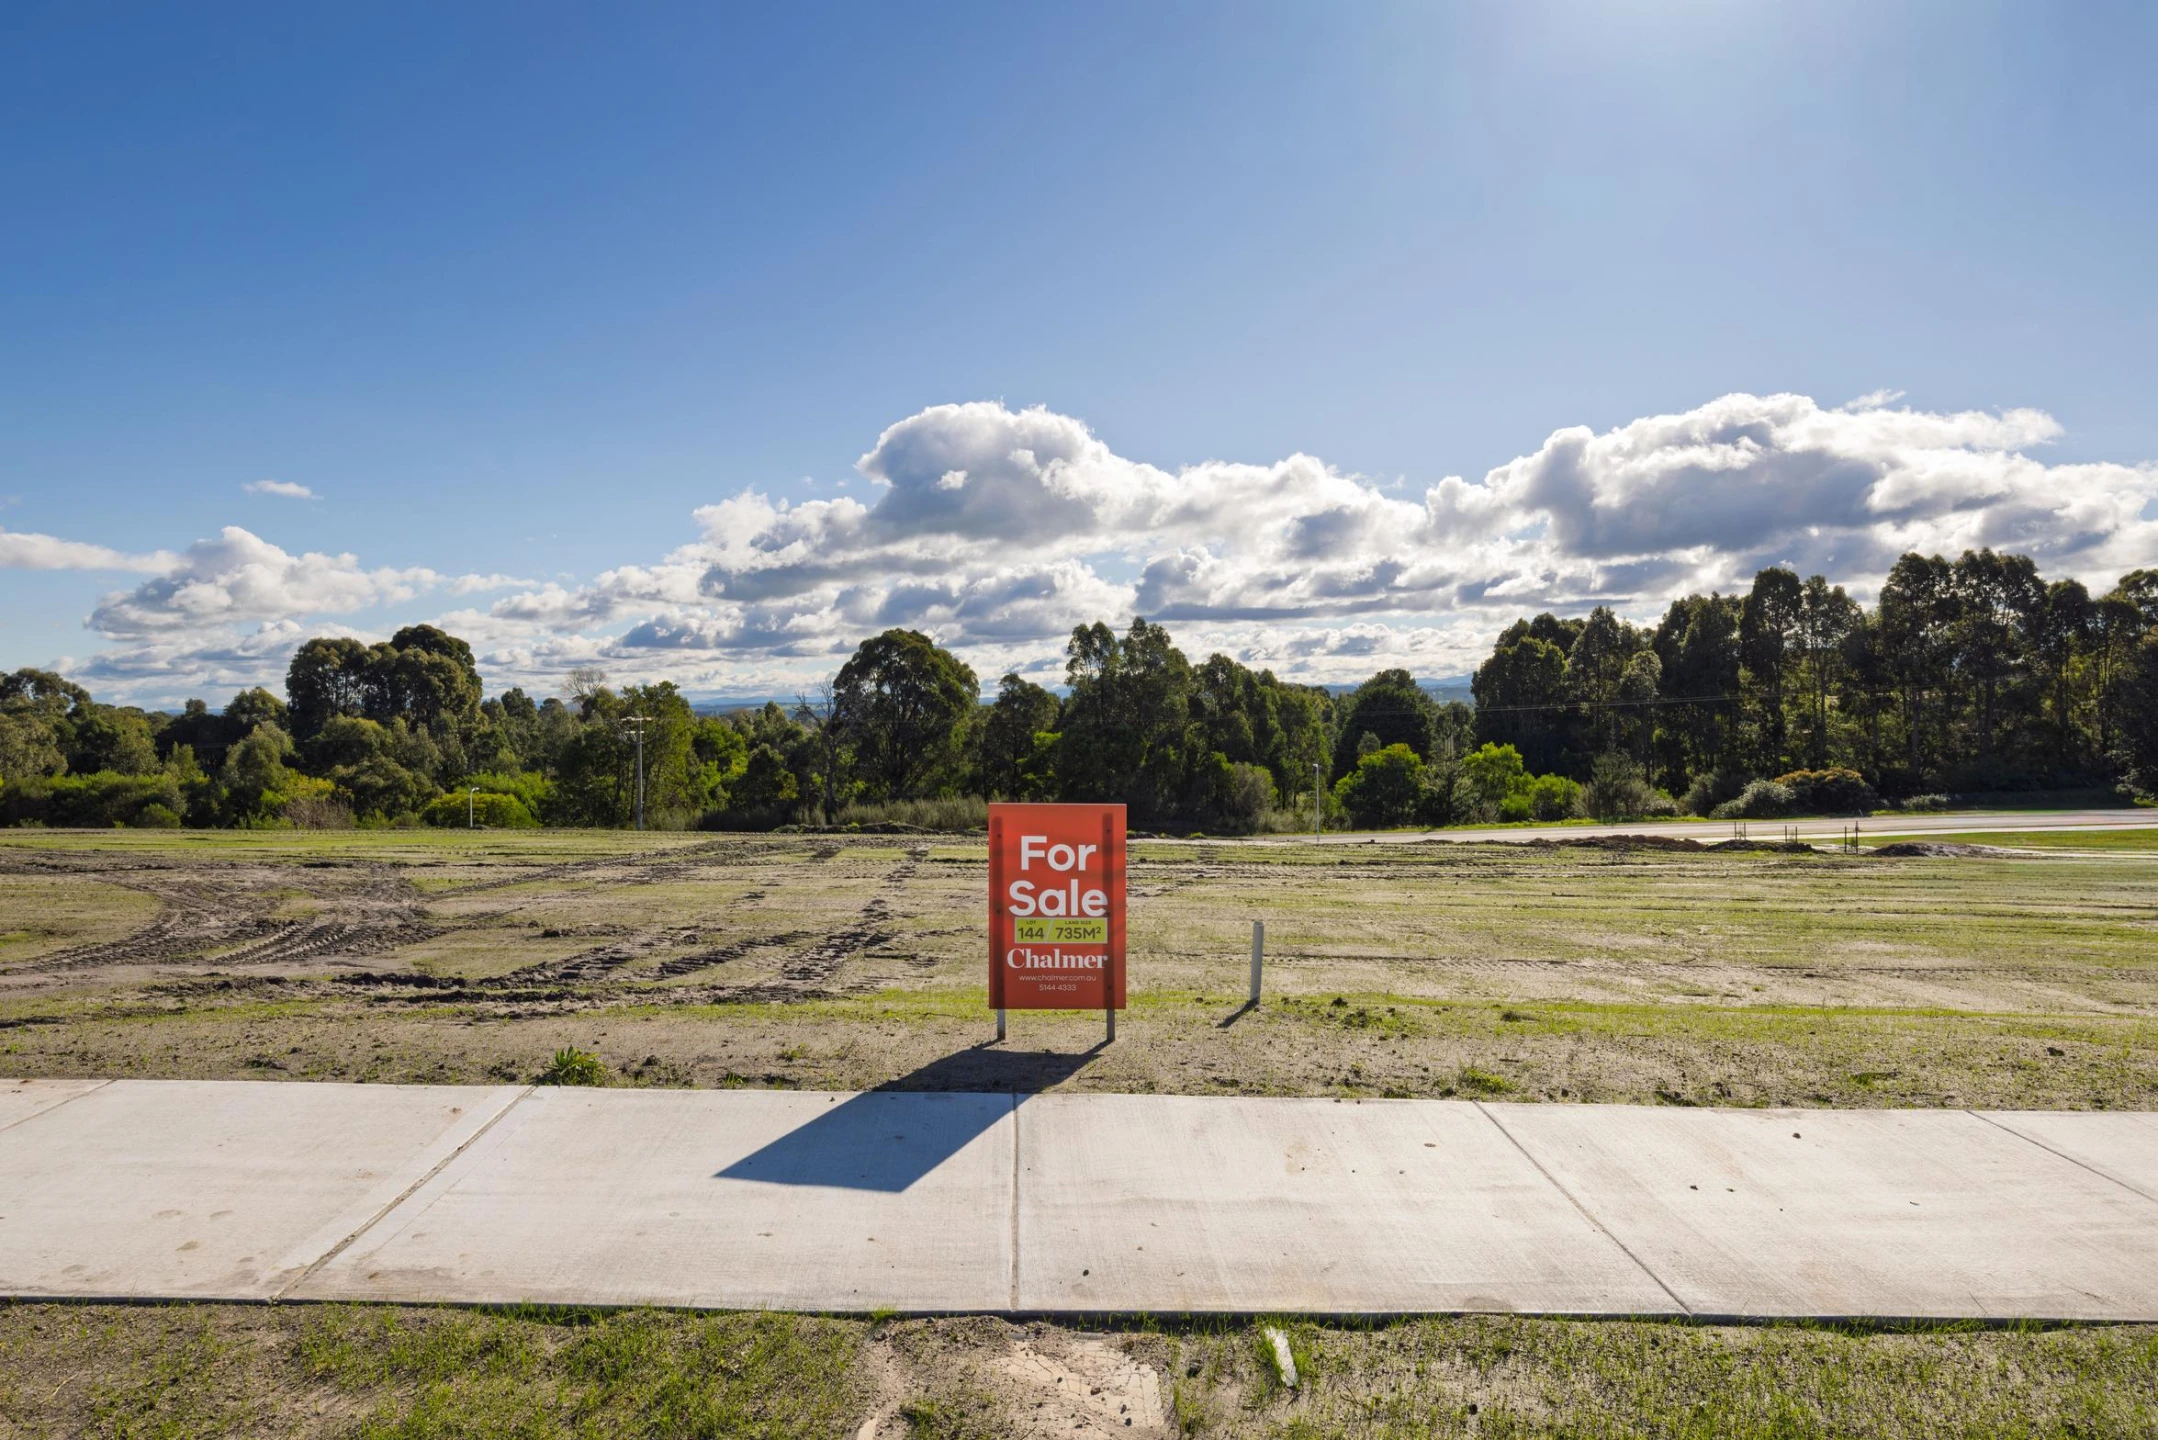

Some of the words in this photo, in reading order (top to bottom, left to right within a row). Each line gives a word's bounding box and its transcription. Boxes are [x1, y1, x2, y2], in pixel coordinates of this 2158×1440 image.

[1021, 835, 1097, 871] For
[1008, 878, 1109, 917] Sale
[1018, 927, 1044, 939] 144
[1006, 948, 1109, 969] Chalmer
[1018, 974, 1097, 982] www.chalmer.com.au
[1039, 984, 1056, 992] 5144
[1057, 984, 1077, 992] 4333
